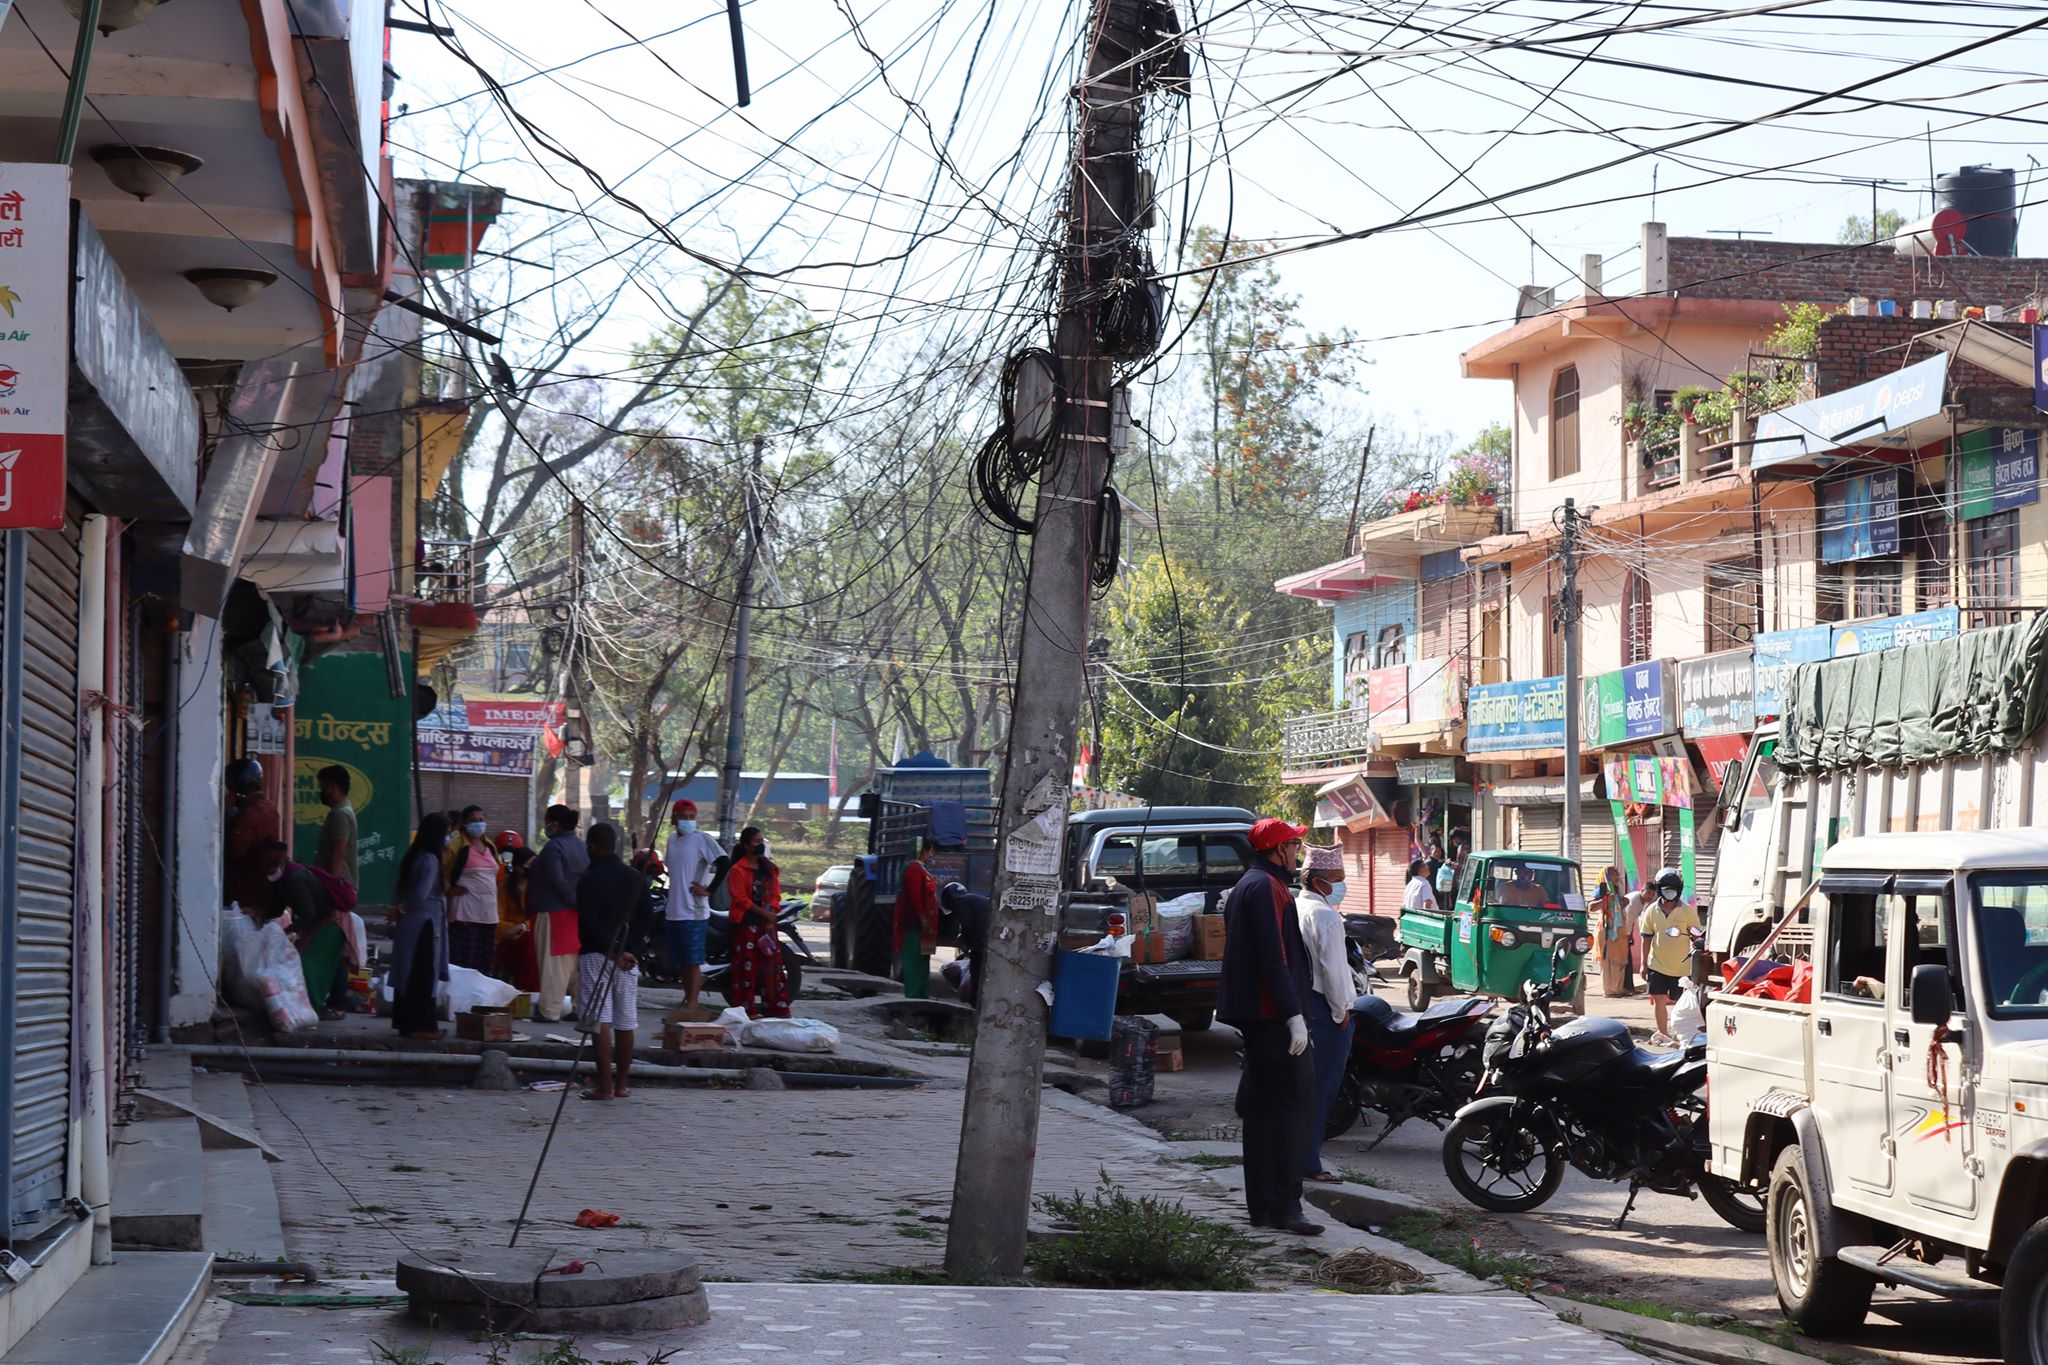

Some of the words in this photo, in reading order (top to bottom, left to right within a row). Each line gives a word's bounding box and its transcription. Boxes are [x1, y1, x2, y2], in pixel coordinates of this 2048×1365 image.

[0, 190, 25, 221] लै
[8, 330, 30, 341] Air
[1893, 379, 1926, 413] pepsi
[2003, 429, 2025, 453] विष्णु
[1995, 459, 2009, 486] होटल
[2010, 459, 2021, 480] एण्ड
[2023, 456, 2034, 477] लज
[317, 713, 393, 751] पेन्ट्स
[469, 733, 532, 751] सप्लायर्स
[1977, 1111, 2002, 1128] BOLERO
